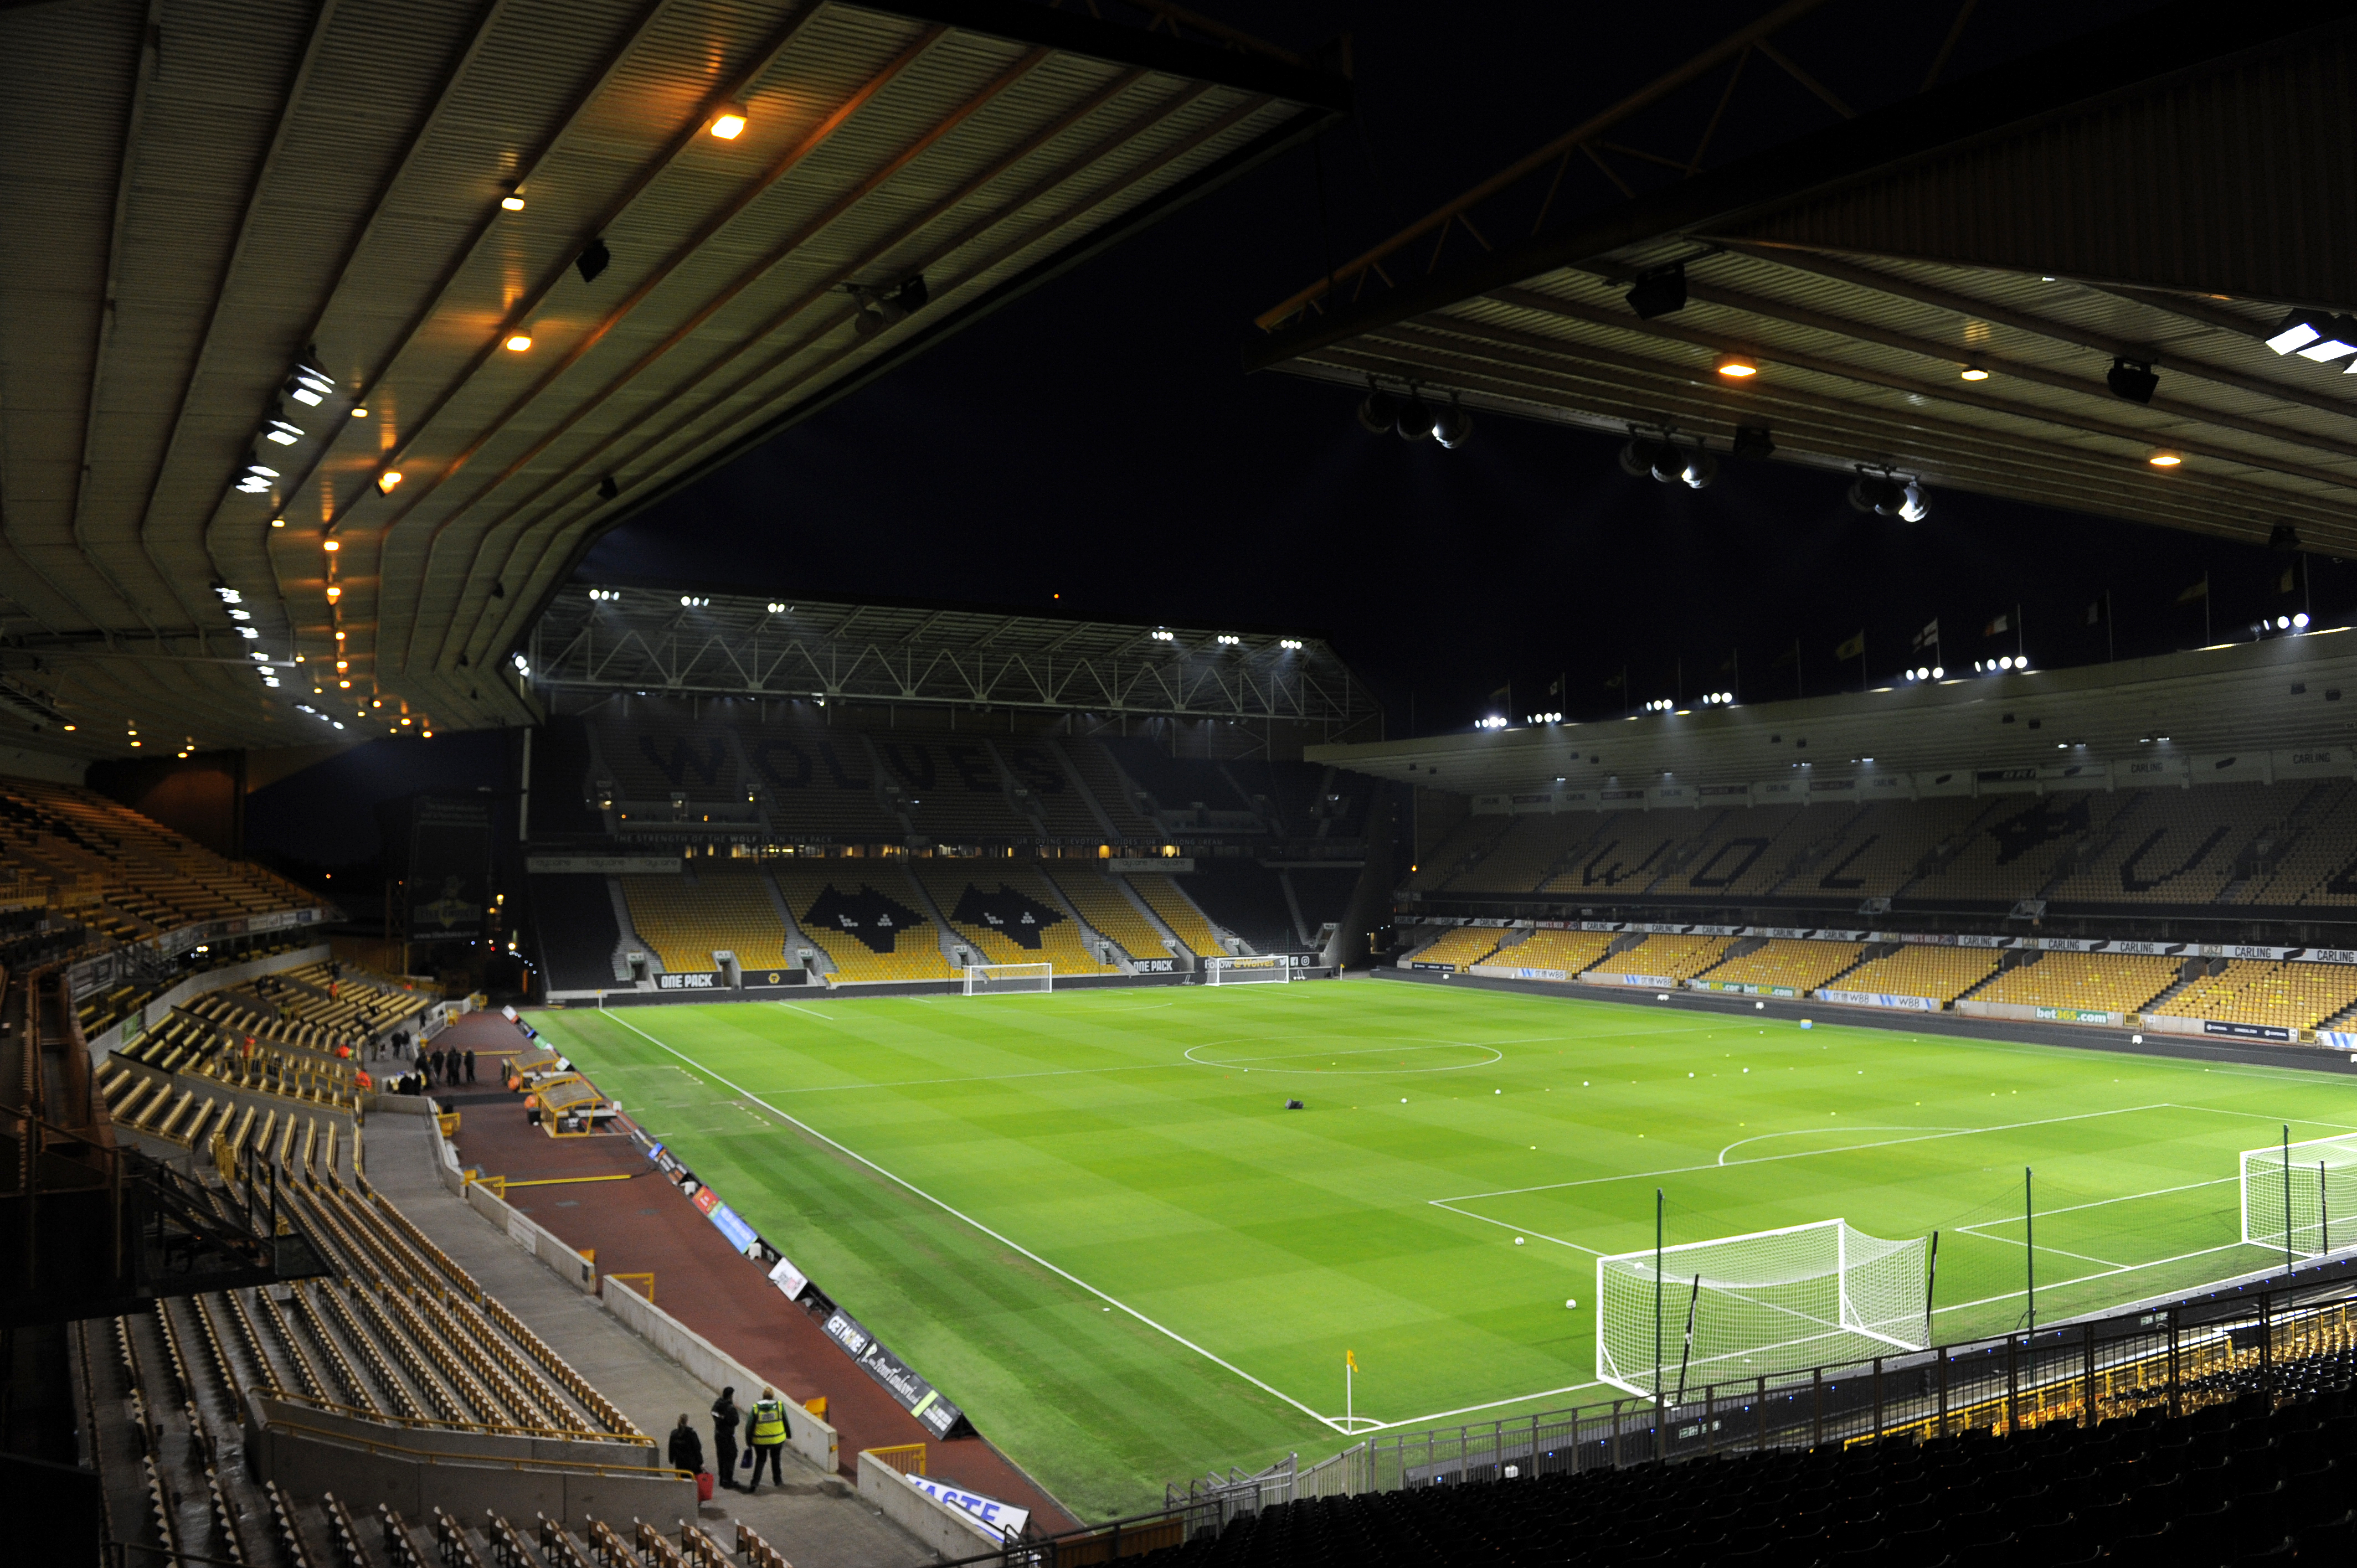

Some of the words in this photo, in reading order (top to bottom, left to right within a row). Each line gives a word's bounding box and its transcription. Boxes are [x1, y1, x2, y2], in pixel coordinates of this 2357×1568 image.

[2293, 752, 2331, 765] CARLING
[639, 735, 1065, 793] WOLVES
[2131, 762, 2163, 773] CARLING
[1874, 777, 1898, 787] CARLING
[614, 835, 631, 843] THE
[637, 835, 688, 843] STRENGTH
[691, 835, 703, 843] OF
[709, 835, 725, 843] THE
[730, 835, 755, 843] WOLF
[761, 835, 771, 843] IS
[775, 835, 785, 843] IN
[789, 835, 805, 843] THE
[810, 835, 832, 843] PACK
[1479, 918, 1498, 926] CARLING
[1587, 922, 1608, 930] CARLING
[1652, 924, 1674, 932] CARLING
[1702, 925, 1725, 935] CARLING
[1773, 929, 1796, 938] CARLING
[1824, 931, 1848, 940] CARLING
[1963, 936, 1993, 946] CARLING
[2048, 940, 2080, 950] CARLING
[2120, 942, 2154, 953] CARLING
[2235, 946, 2272, 958] CARLING
[2317, 950, 2355, 962] CARLING
[1133, 961, 1150, 972] ONE
[1151, 960, 1173, 972] PACK
[1233, 958, 1275, 968] @Wolves
[1548, 971, 1564, 979] W88
[661, 974, 683, 988] ONE
[684, 974, 713, 988] PACK
[1743, 984, 1794, 997] bet365.com
[1850, 994, 1869, 1004] W88
[1899, 998, 1920, 1008] W88
[2036, 1007, 2107, 1023] bet365.com
[827, 1316, 848, 1336] GET
[838, 1326, 866, 1353] MORE
